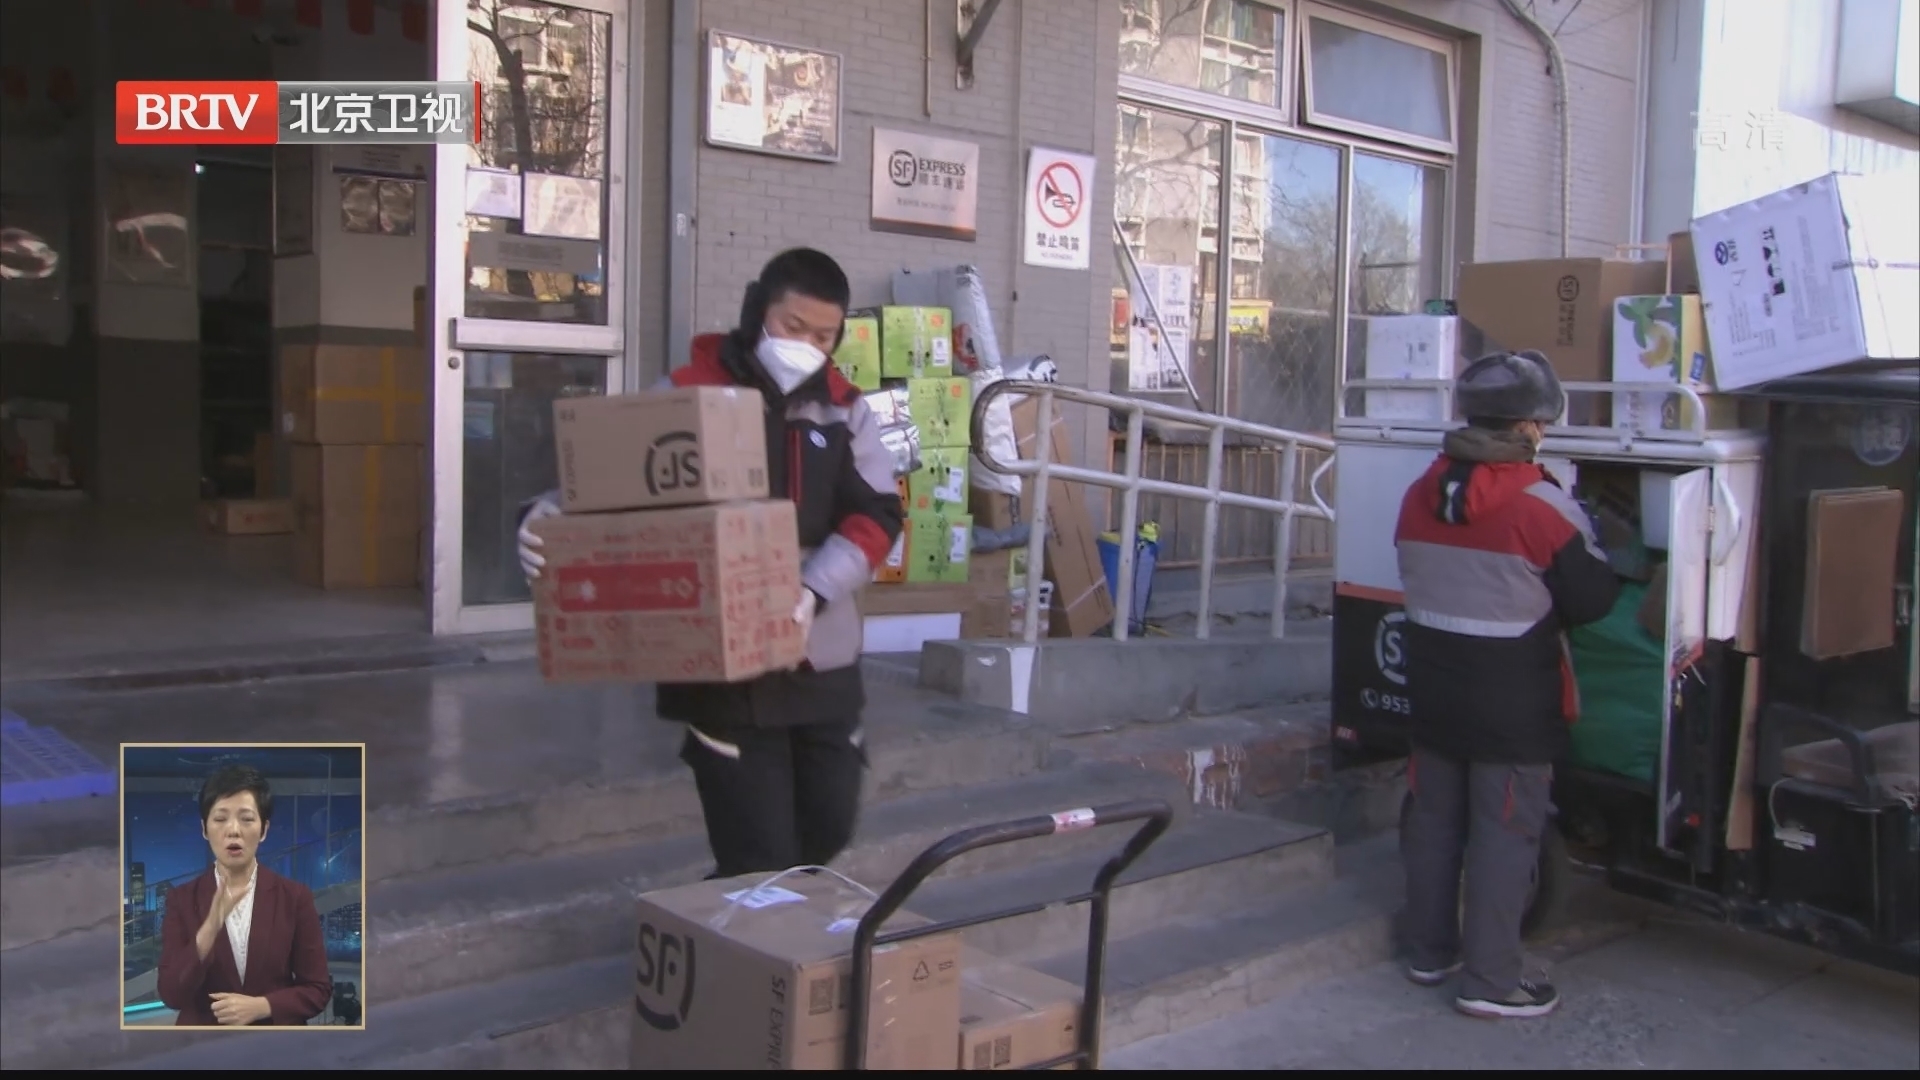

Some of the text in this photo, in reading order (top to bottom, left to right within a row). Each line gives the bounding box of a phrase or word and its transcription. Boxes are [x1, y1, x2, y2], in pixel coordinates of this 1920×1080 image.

[918, 157, 967, 177] EXPRESS
[658, 449, 700, 489] SF
[636, 922, 682, 996] SF
